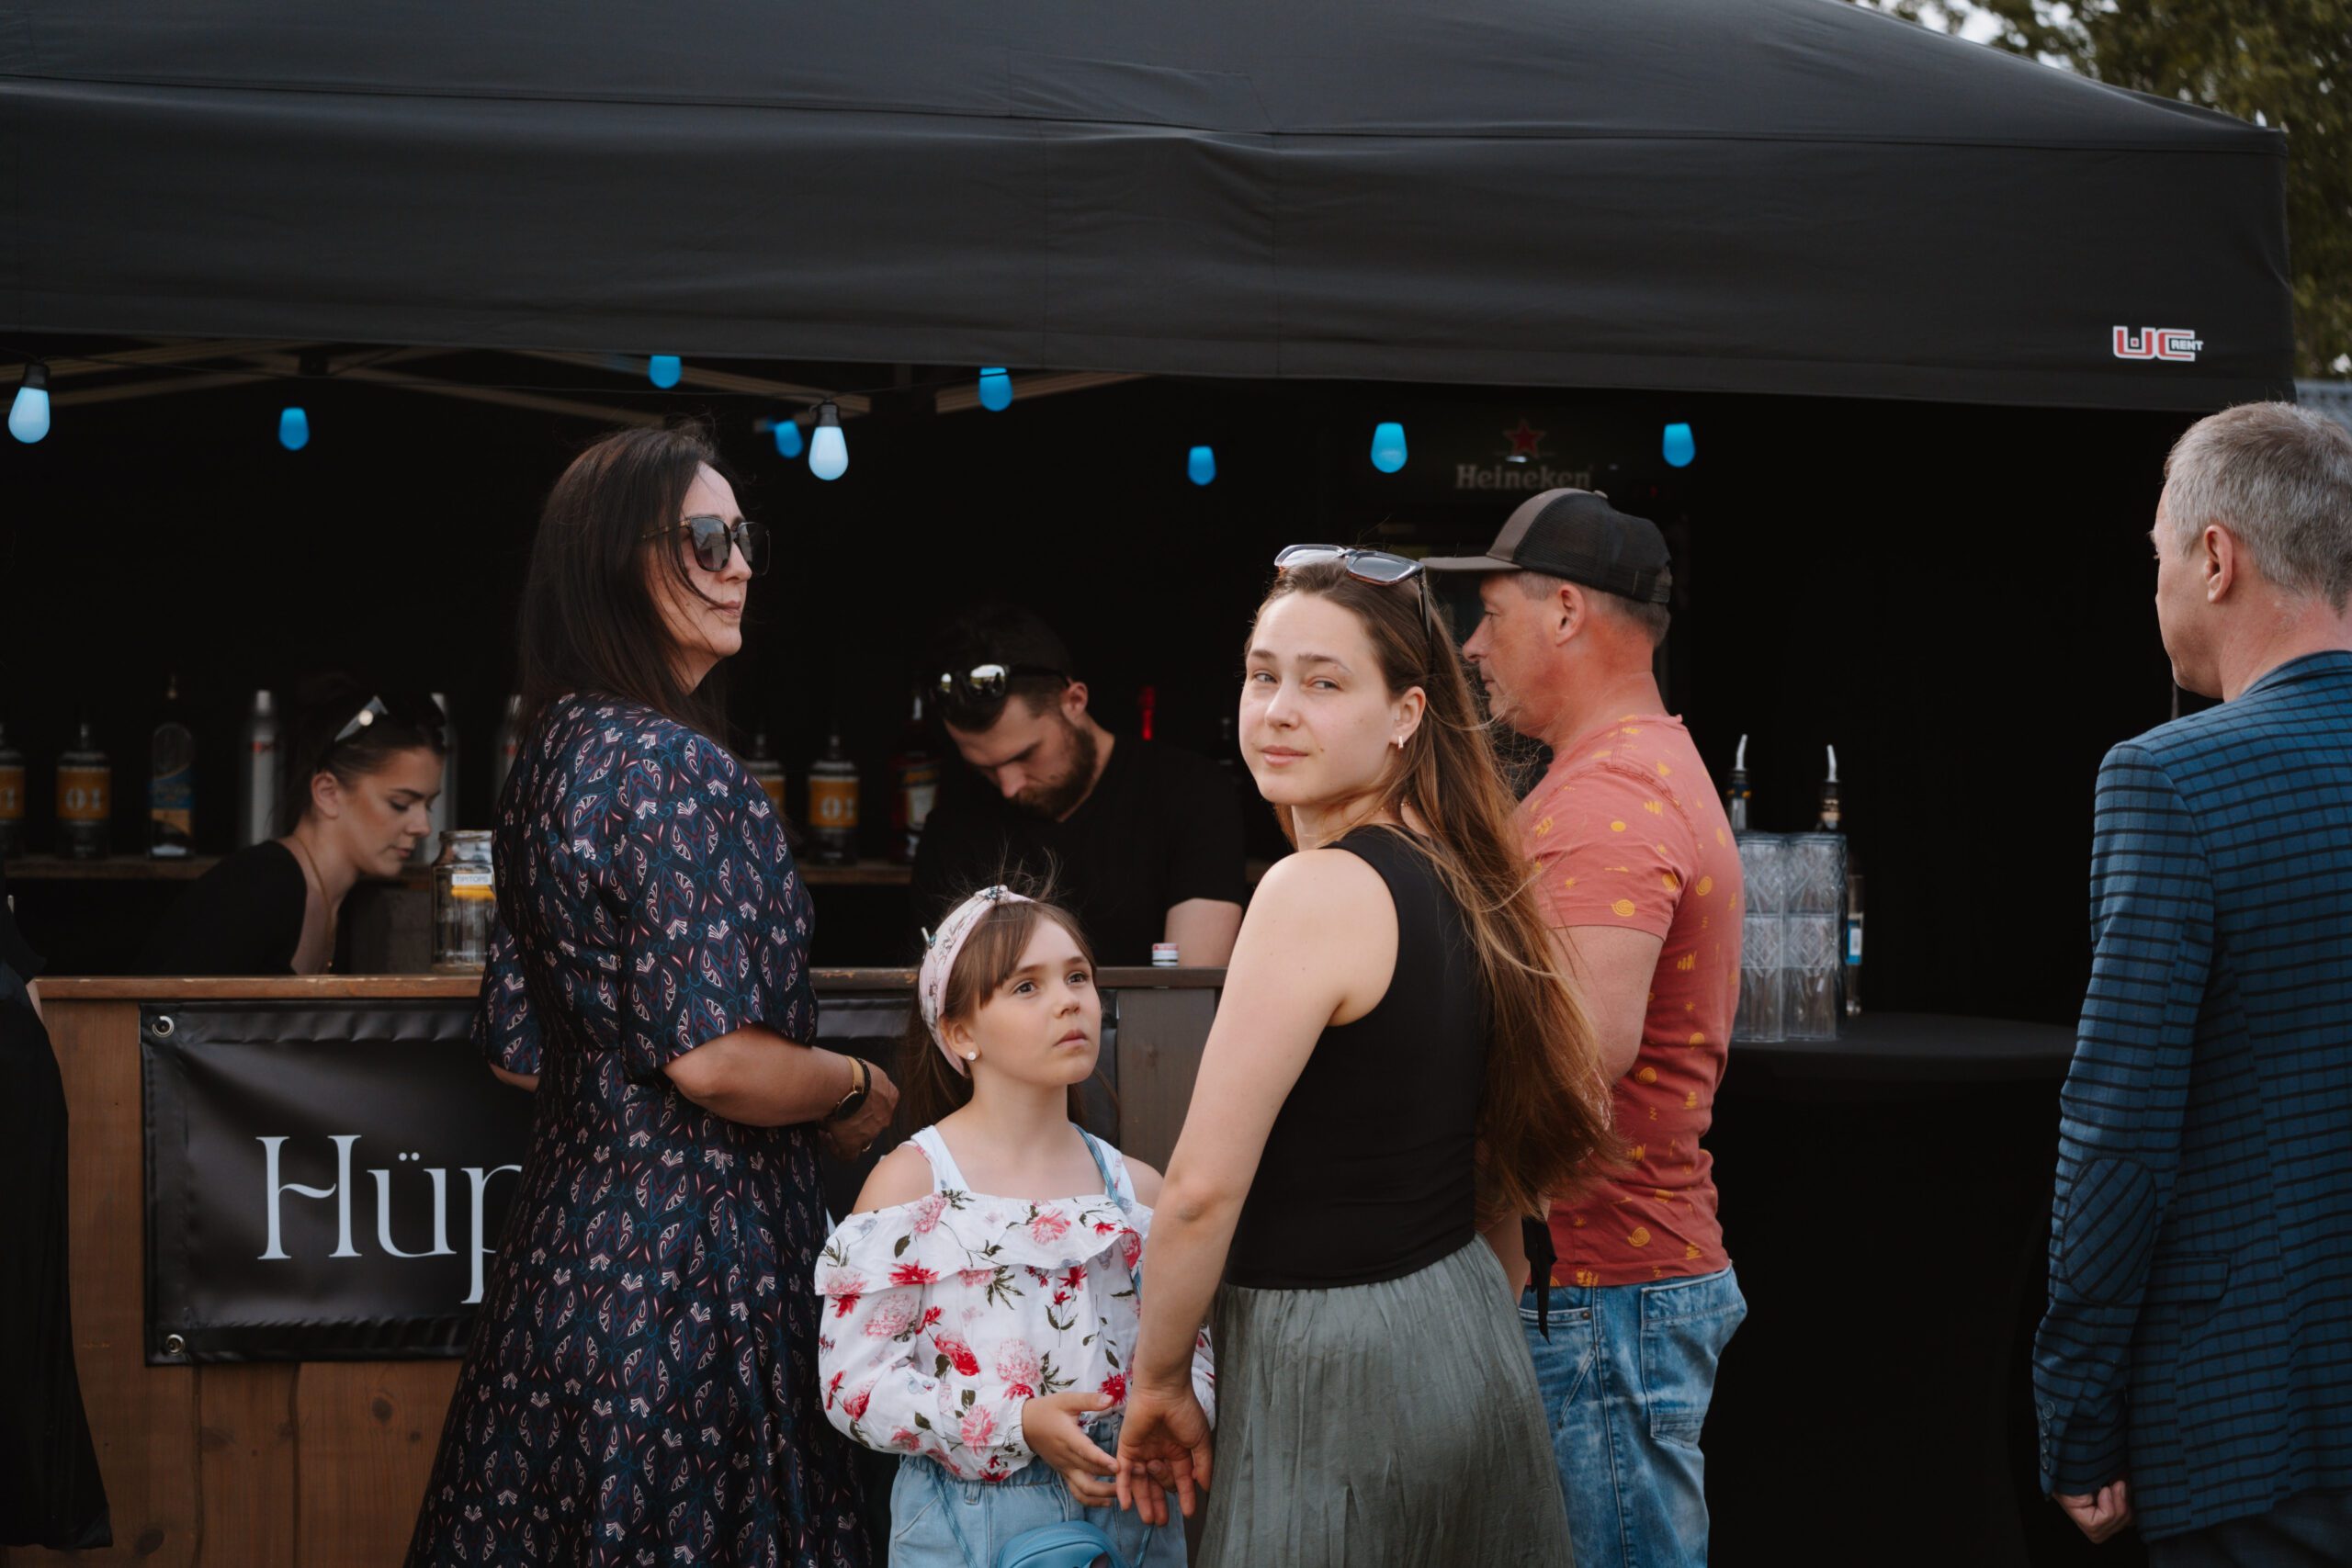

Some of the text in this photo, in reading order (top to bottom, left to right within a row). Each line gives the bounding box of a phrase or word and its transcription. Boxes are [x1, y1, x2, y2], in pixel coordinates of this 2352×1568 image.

[2170, 339, 2204, 352] RENT
[1455, 463, 1591, 490] Heineken
[65, 786, 102, 811] 01
[820, 795, 855, 820] 01
